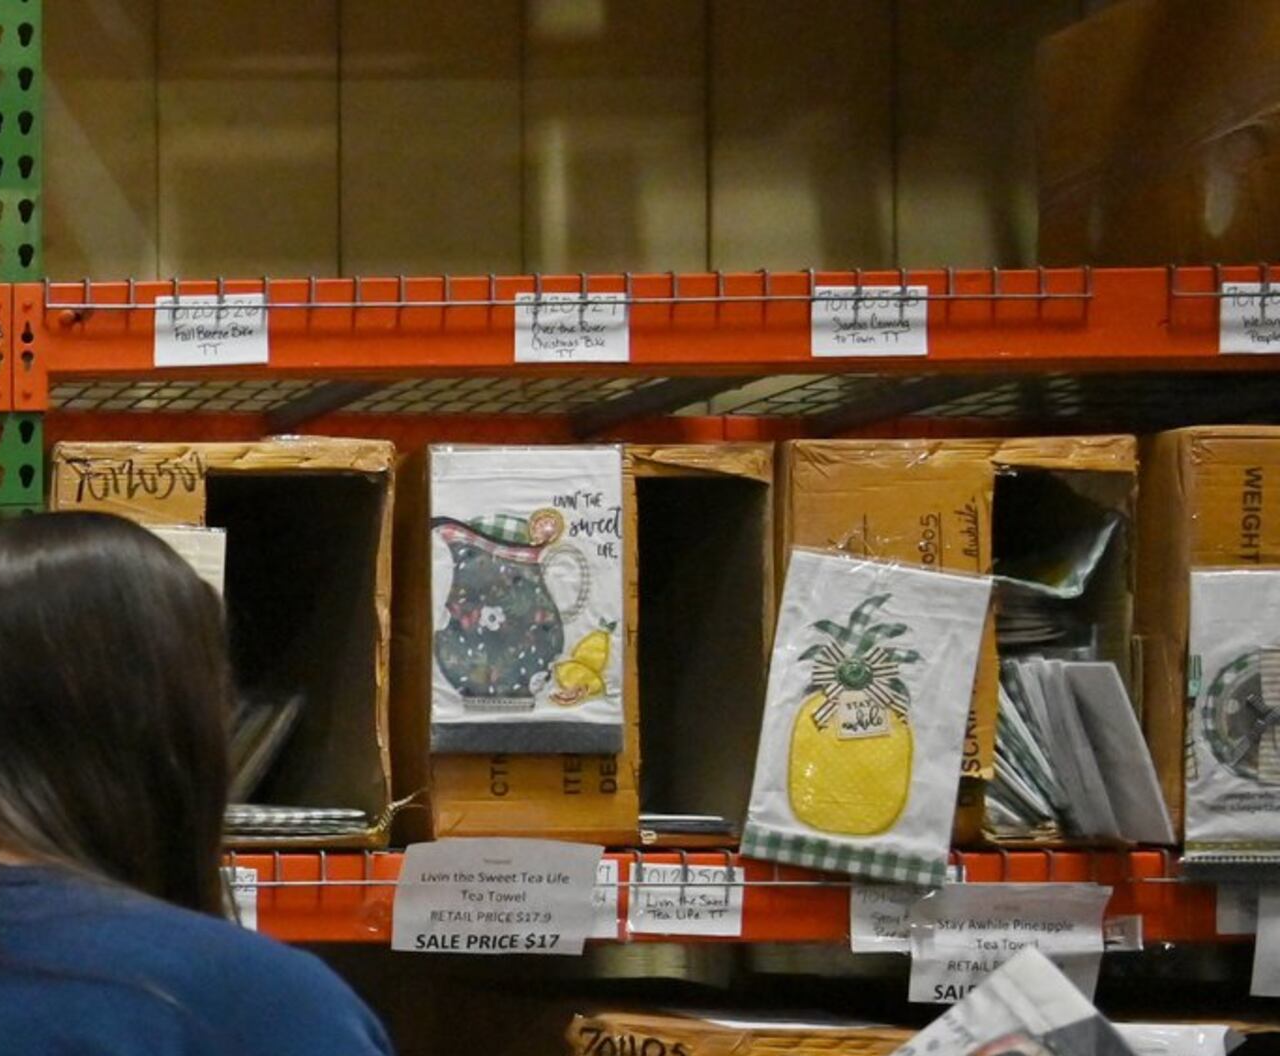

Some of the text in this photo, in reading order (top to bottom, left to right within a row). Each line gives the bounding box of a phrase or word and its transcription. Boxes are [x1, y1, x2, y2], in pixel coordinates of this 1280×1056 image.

[569, 507, 622, 538] sweet
[421, 872, 570, 884] Livin the Sweet Tea Life
[461, 890, 526, 902] Tea Towel
[430, 910, 472, 923] RETAIL
[477, 911, 511, 923] PRICE
[938, 918, 1073, 933] Stay Awhile Pineapple
[416, 932, 560, 949] SALE PRICE $17
[976, 938, 998, 950] Tea
[947, 960, 989, 972] RETAIL
